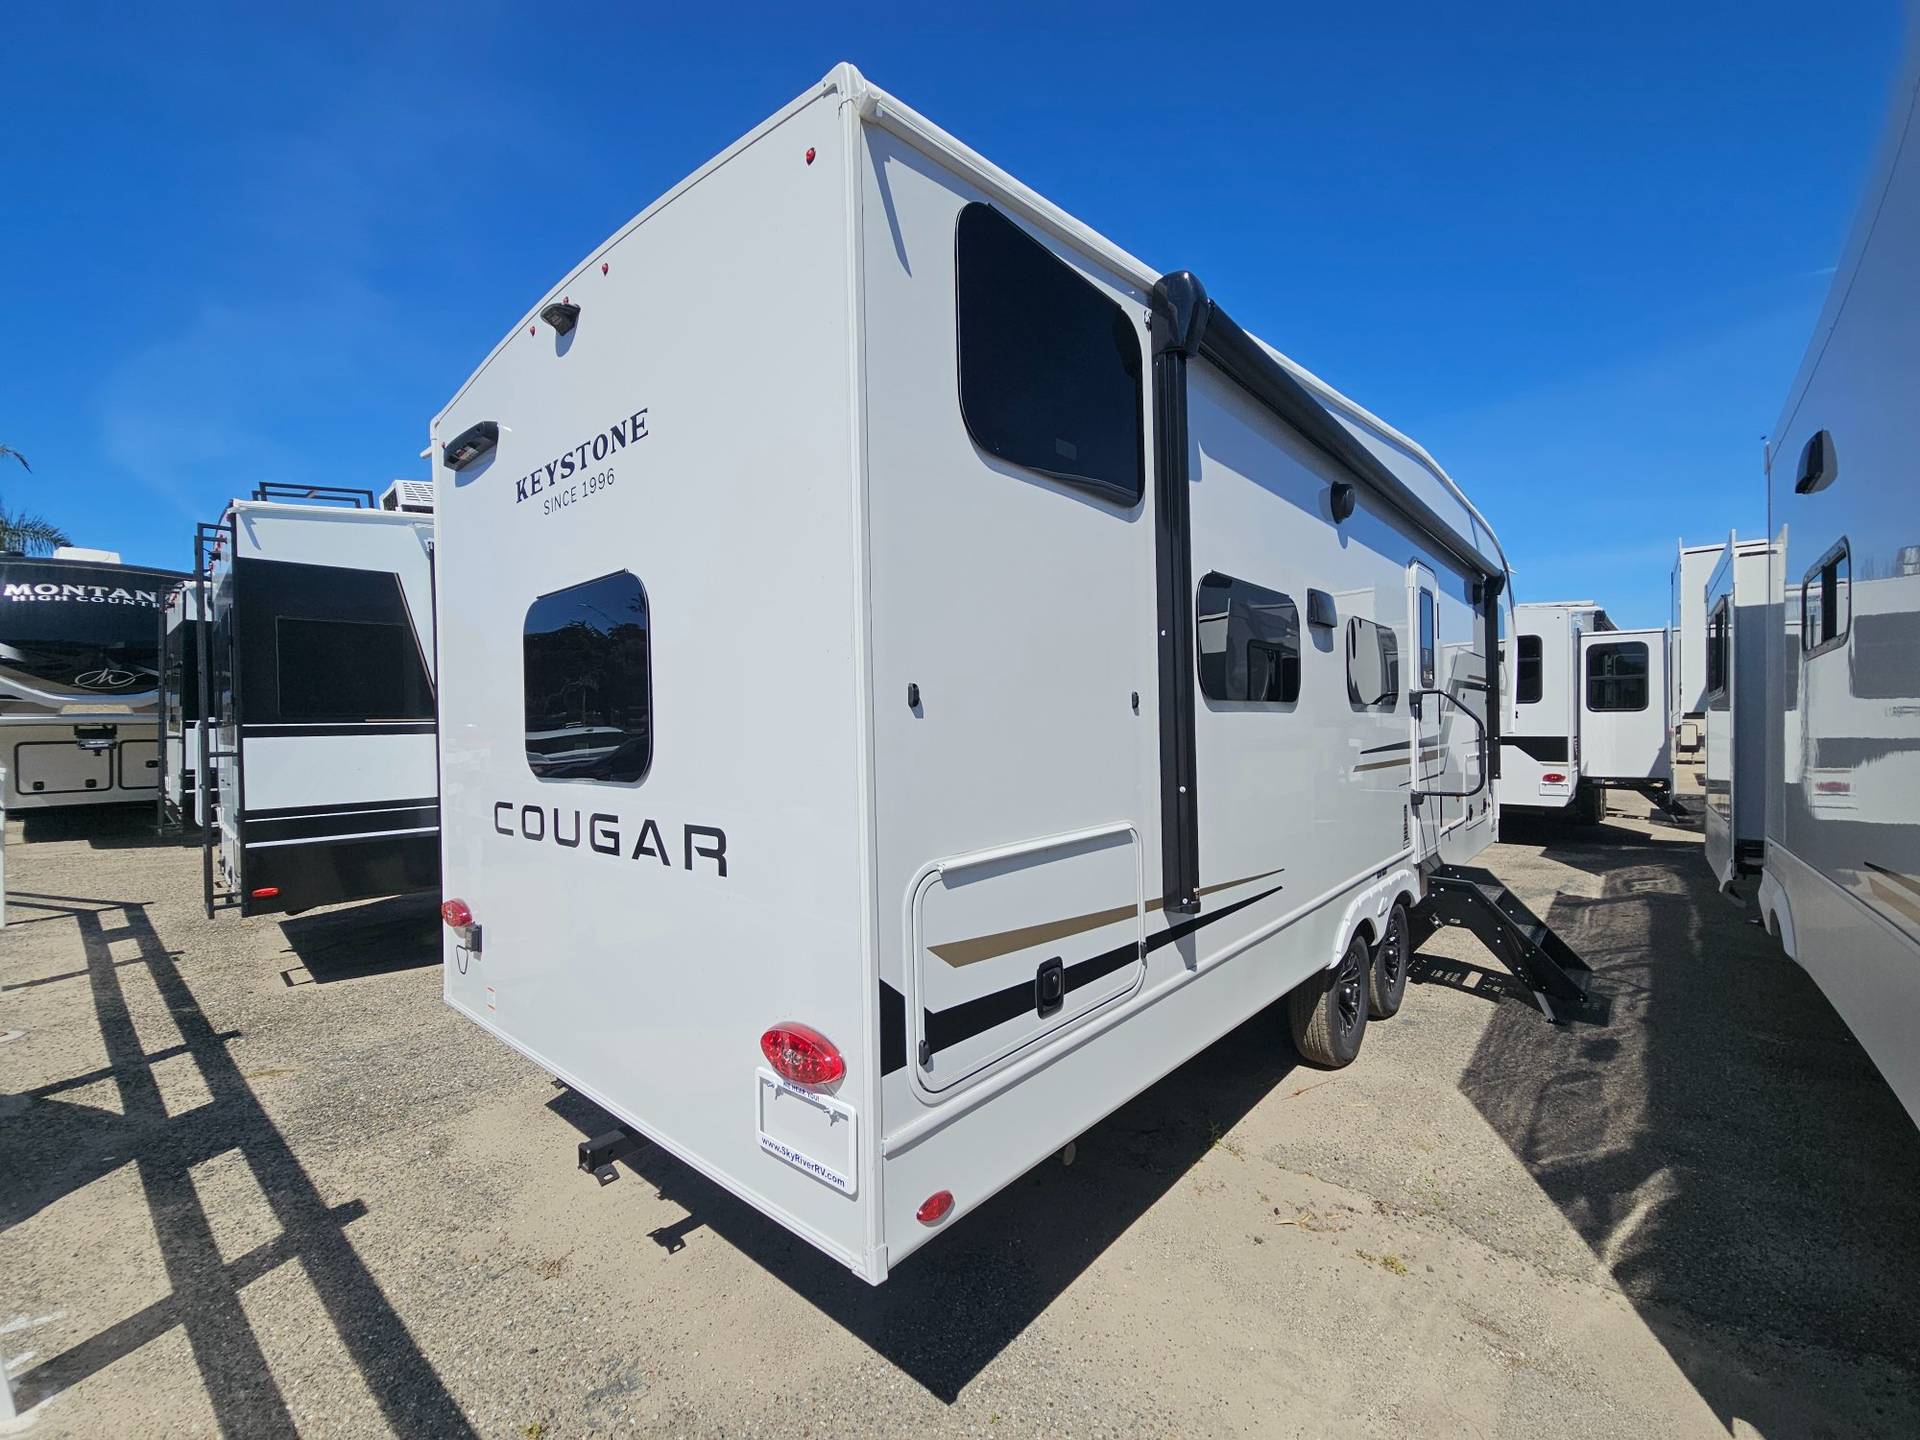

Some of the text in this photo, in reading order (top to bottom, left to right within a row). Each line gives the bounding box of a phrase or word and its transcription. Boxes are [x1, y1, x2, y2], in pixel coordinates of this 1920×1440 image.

[515, 407, 649, 504] KEYSTONE
[543, 467, 615, 515] SINCE 1996
[3, 583, 158, 603] MONTAN
[12, 594, 161, 609] HIGH COUNTR
[494, 801, 728, 878] COUGAR
[761, 1136, 845, 1187] www.SkyRiverRV.com
